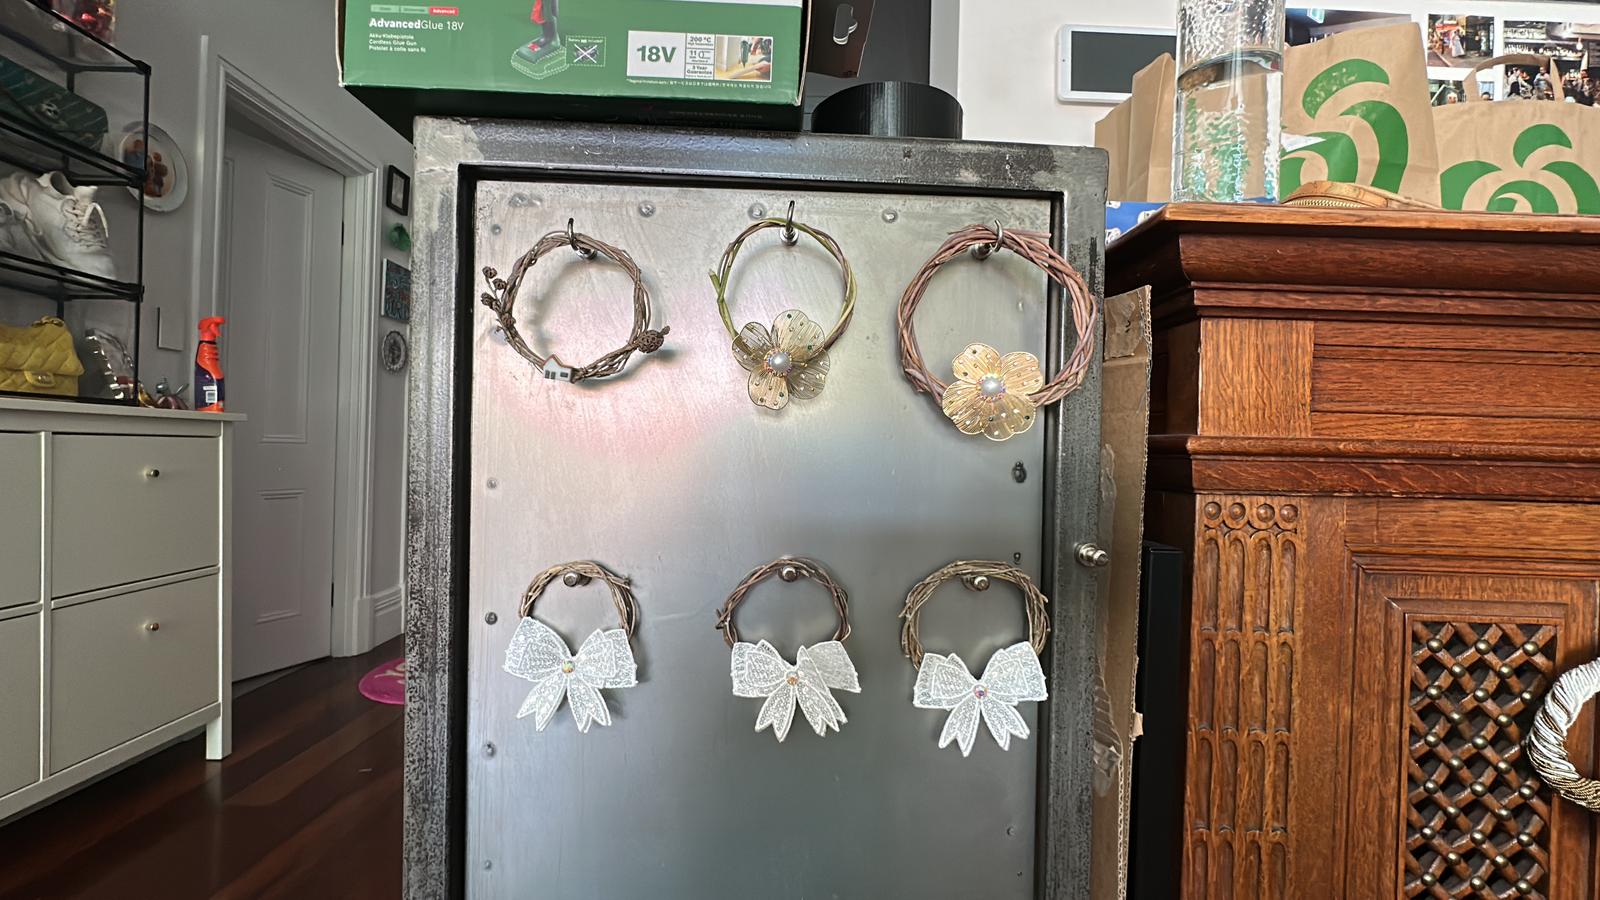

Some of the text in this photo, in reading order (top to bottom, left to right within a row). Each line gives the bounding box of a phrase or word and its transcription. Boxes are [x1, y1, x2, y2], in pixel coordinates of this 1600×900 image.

[369, 18, 464, 30] AdvancedGlue 18V
[636, 45, 677, 63] 18V
